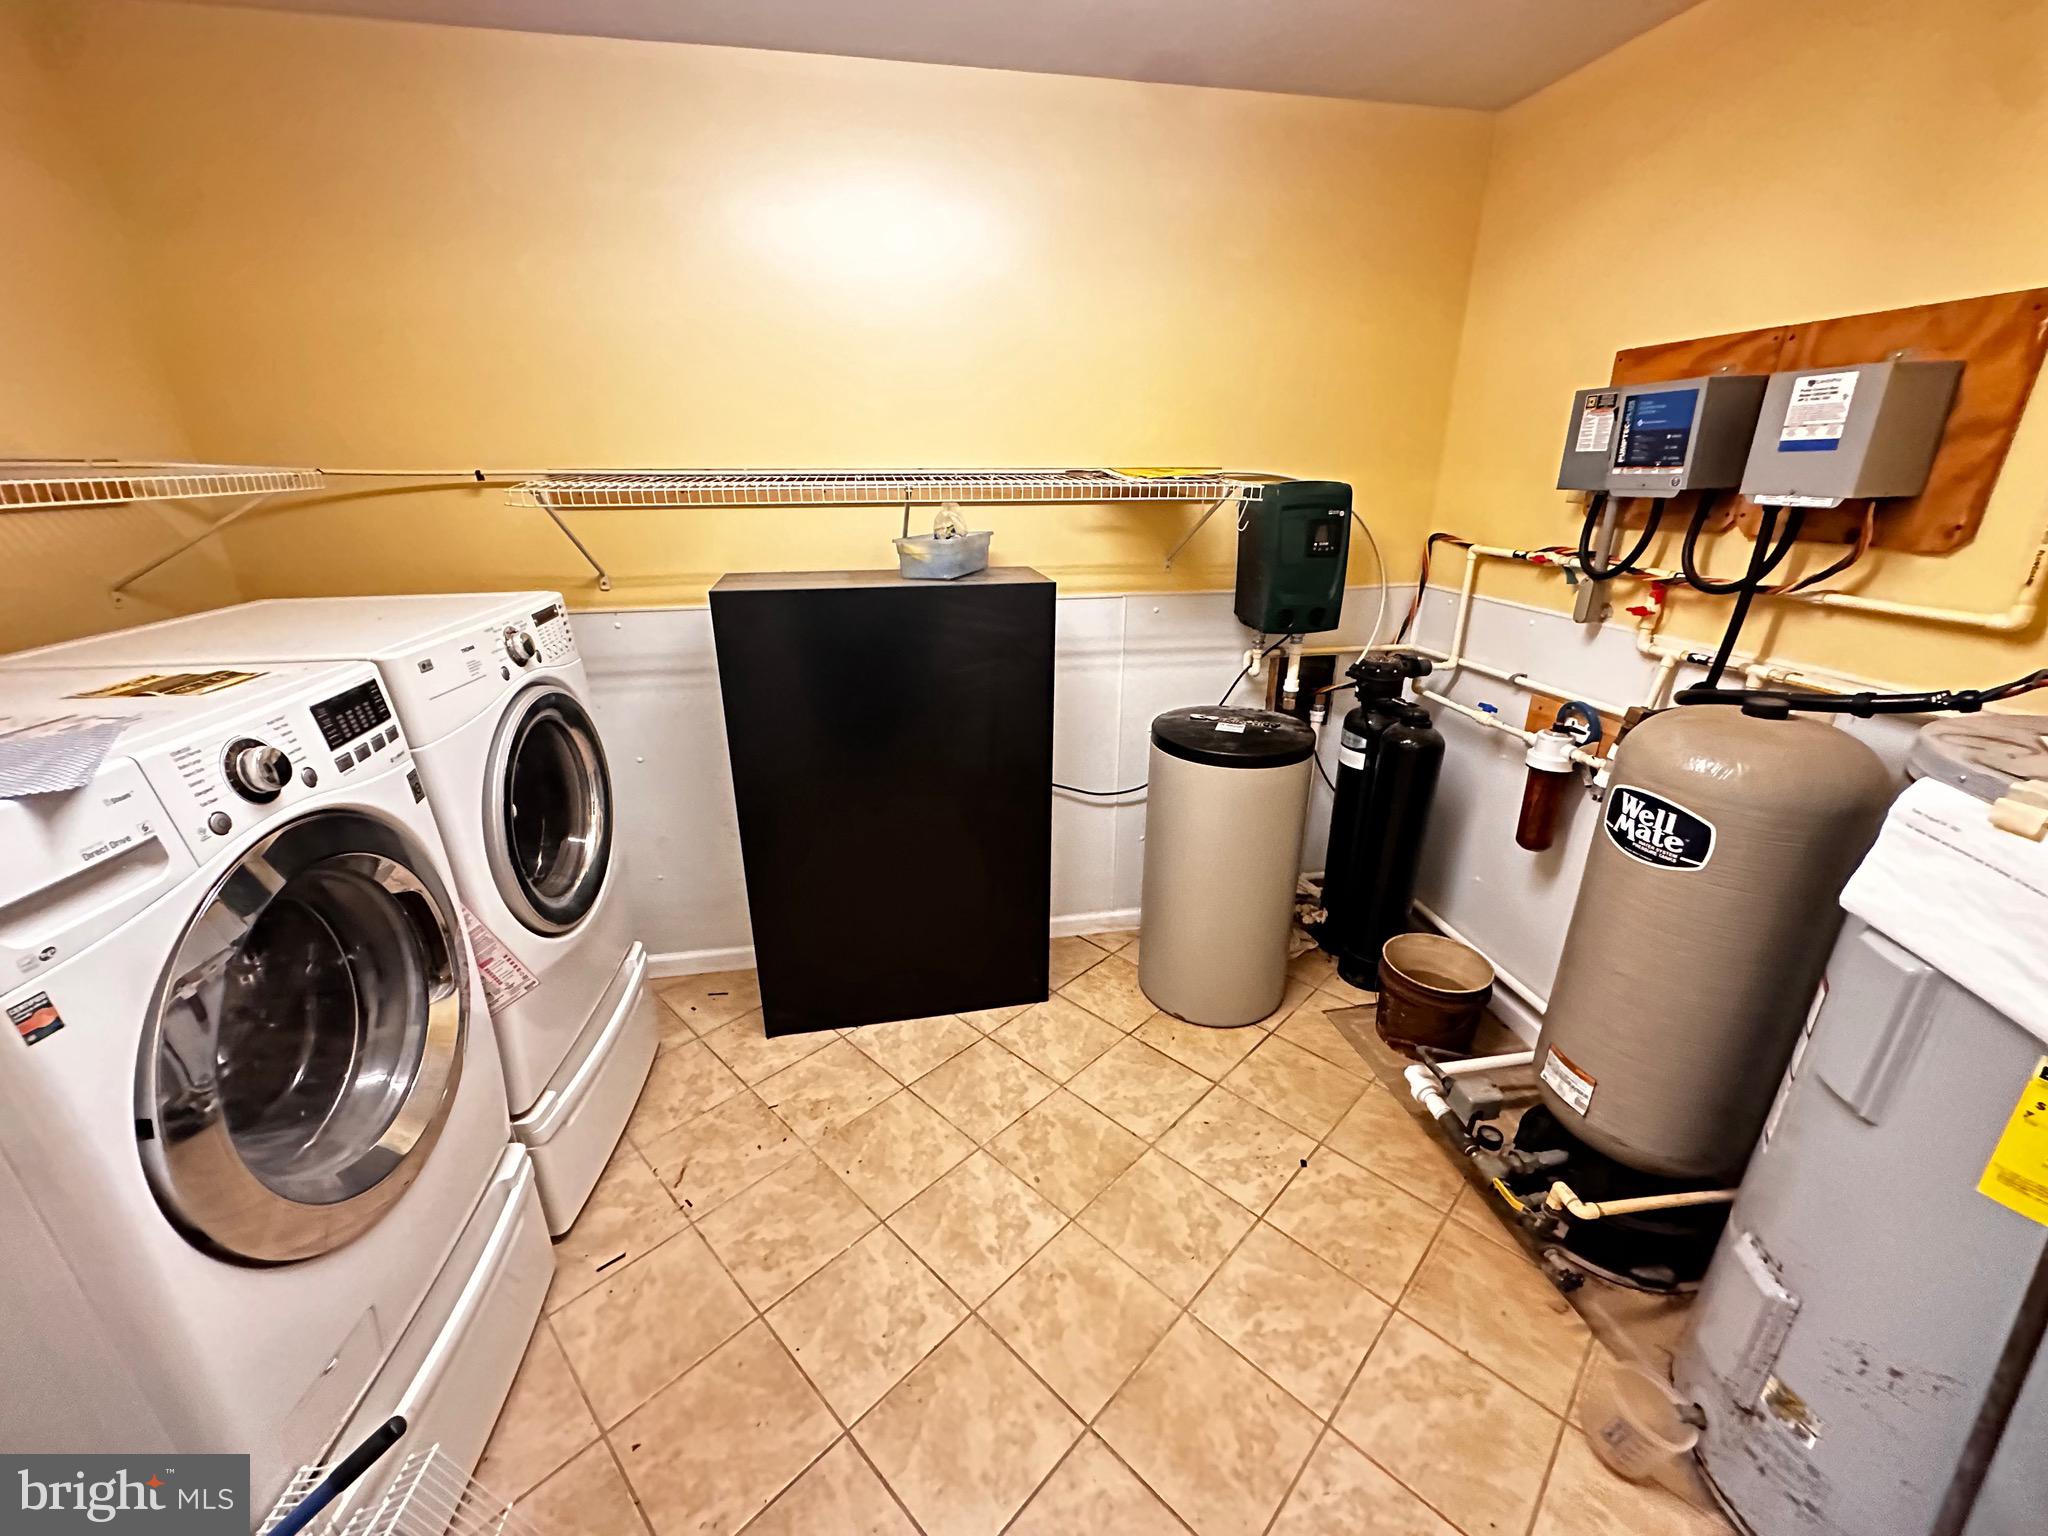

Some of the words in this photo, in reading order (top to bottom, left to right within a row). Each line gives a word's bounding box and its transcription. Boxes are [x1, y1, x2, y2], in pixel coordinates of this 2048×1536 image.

[1613, 813, 1685, 853] Mate
[1622, 791, 1677, 835] Well
[81, 843, 108, 861] Direct
[109, 835, 132, 849] Drive
